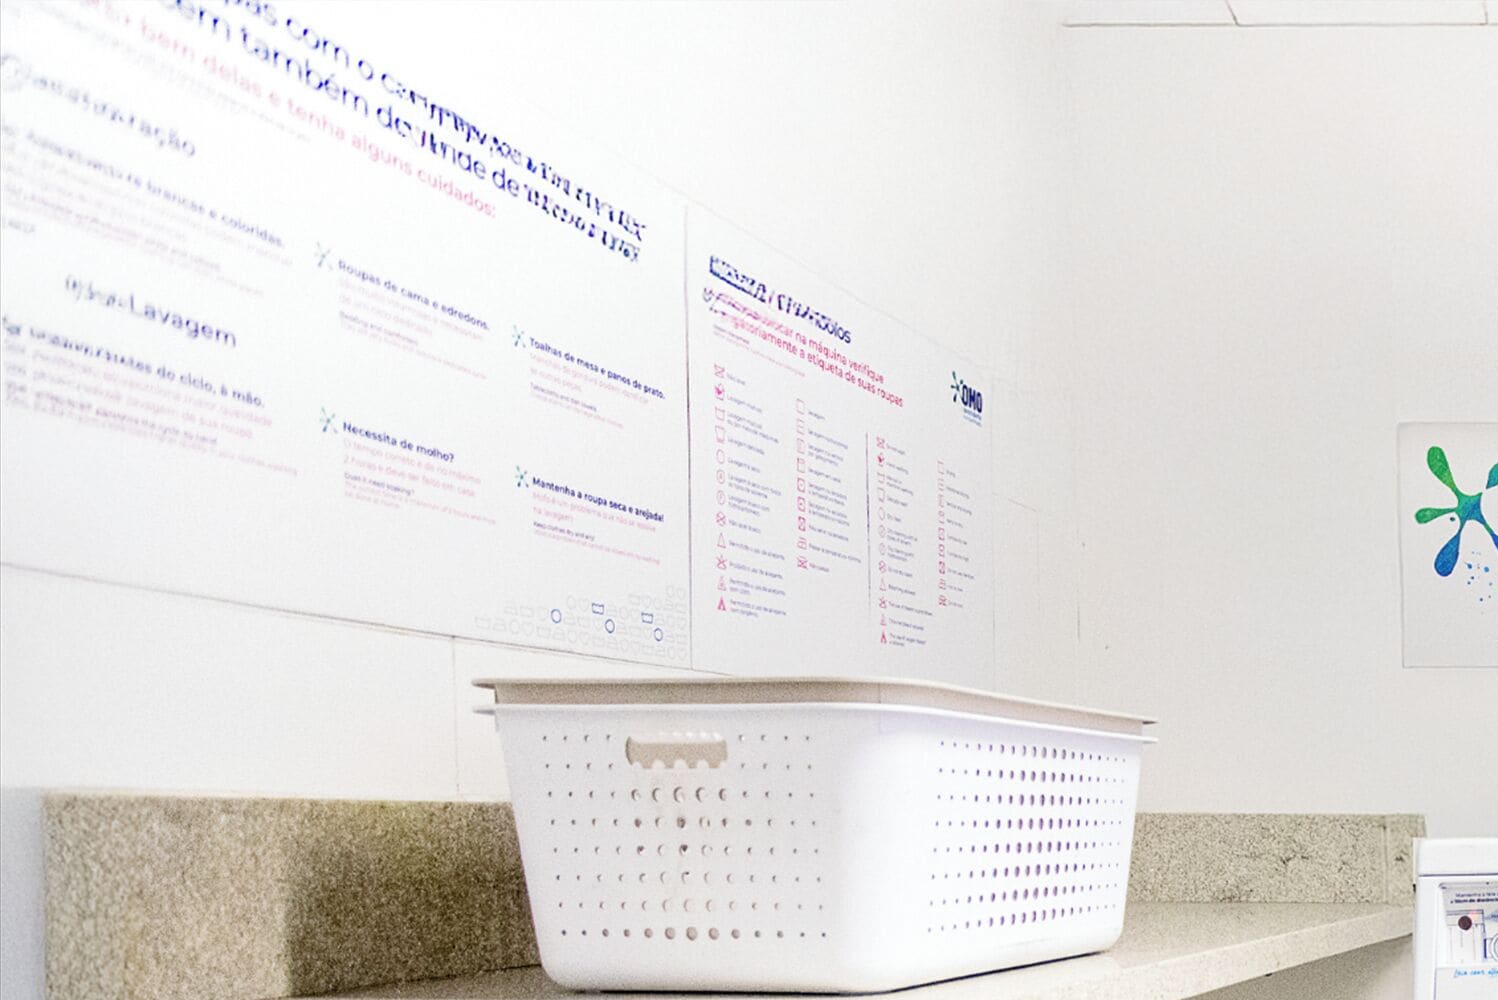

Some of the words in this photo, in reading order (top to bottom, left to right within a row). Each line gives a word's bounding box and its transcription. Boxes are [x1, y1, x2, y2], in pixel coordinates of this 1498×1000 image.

[240, 25, 368, 117] também
[286, 17, 350, 69] com
[357, 59, 374, 81] o
[203, 56, 261, 98] delas
[268, 92, 281, 106] e
[287, 97, 346, 142] tenha
[351, 132, 413, 178] alguns
[416, 167, 496, 219] cuidados:
[337, 259, 382, 287] Roupas
[384, 278, 398, 294] de
[400, 287, 430, 306] cama
[432, 299, 440, 308] e
[127, 293, 237, 348] Lavagem
[529, 336, 563, 359] Toalhas
[564, 351, 576, 364] de
[577, 356, 600, 374] mesa
[600, 366, 607, 375] e
[607, 369, 631, 388] panos
[632, 378, 644, 392] de
[795, 331, 807, 346] na
[808, 338, 848, 367] máquina
[848, 359, 884, 385] verifique
[799, 348, 806, 360] a
[807, 352, 844, 380] etiqueta
[843, 370, 856, 385] de
[857, 378, 876, 397] suas
[877, 386, 904, 409] roupas
[342, 421, 398, 447] Necessita
[400, 438, 413, 451] de
[416, 443, 455, 463] molho?
[532, 476, 576, 499] Mantenha
[577, 490, 583, 500] a
[584, 492, 607, 509] roupa
[609, 500, 627, 513] seca
[628, 506, 634, 514] e
